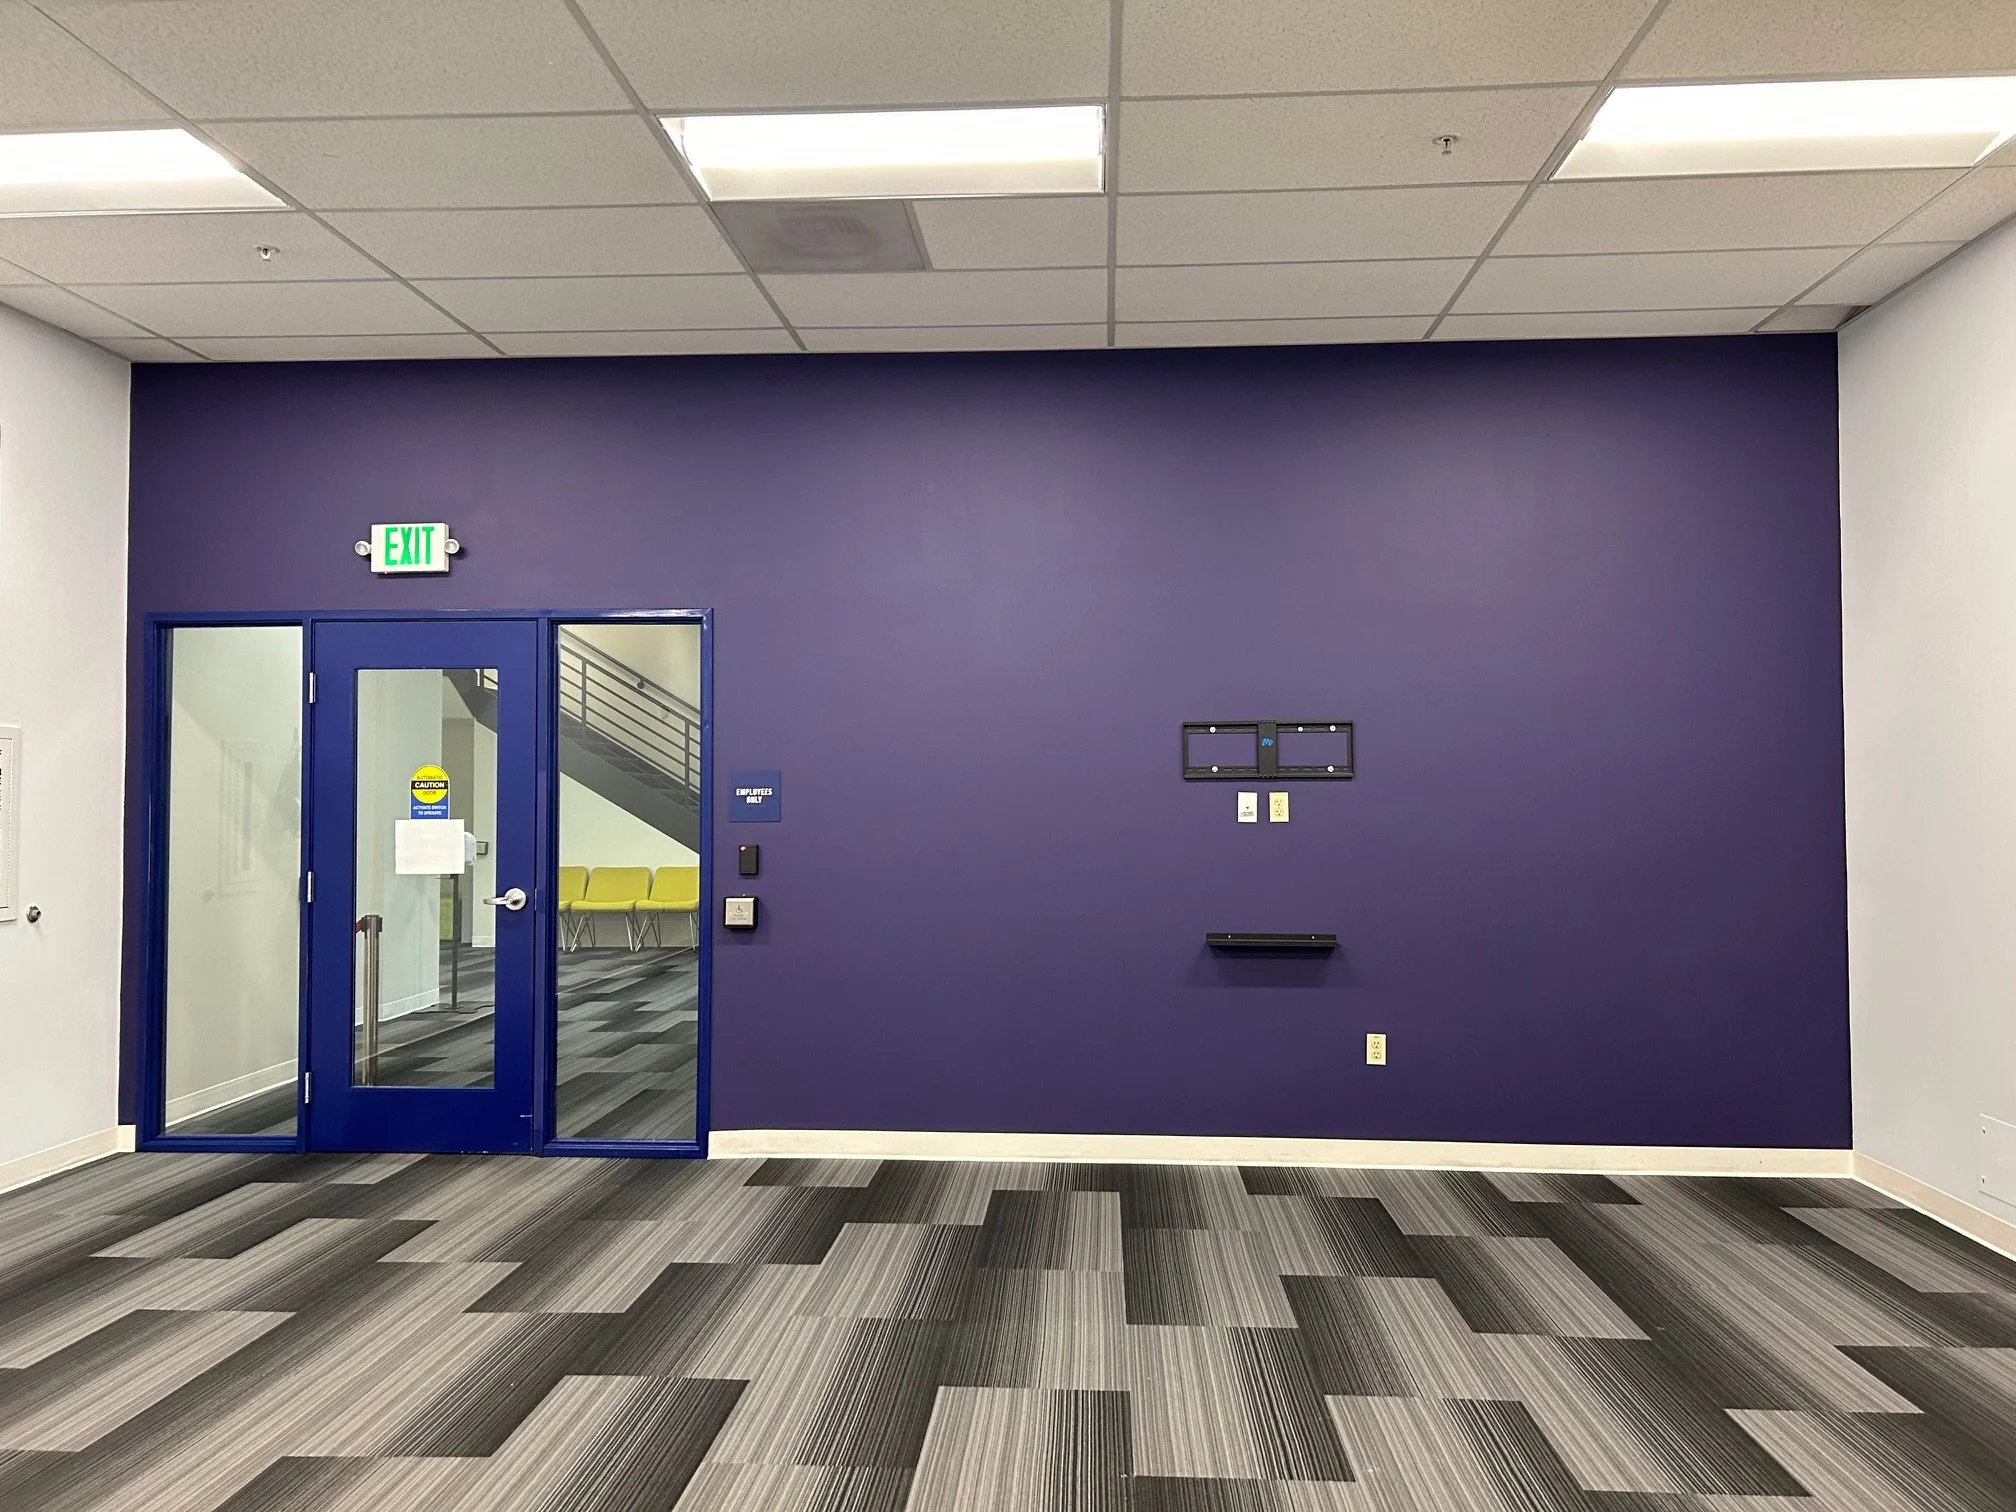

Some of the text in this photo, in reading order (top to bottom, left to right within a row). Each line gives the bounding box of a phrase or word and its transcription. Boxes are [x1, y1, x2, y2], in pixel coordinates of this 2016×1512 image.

[384, 526, 435, 566] EXIT
[736, 788, 773, 796] EMPLOYEES
[746, 796, 763, 804] ONLY
